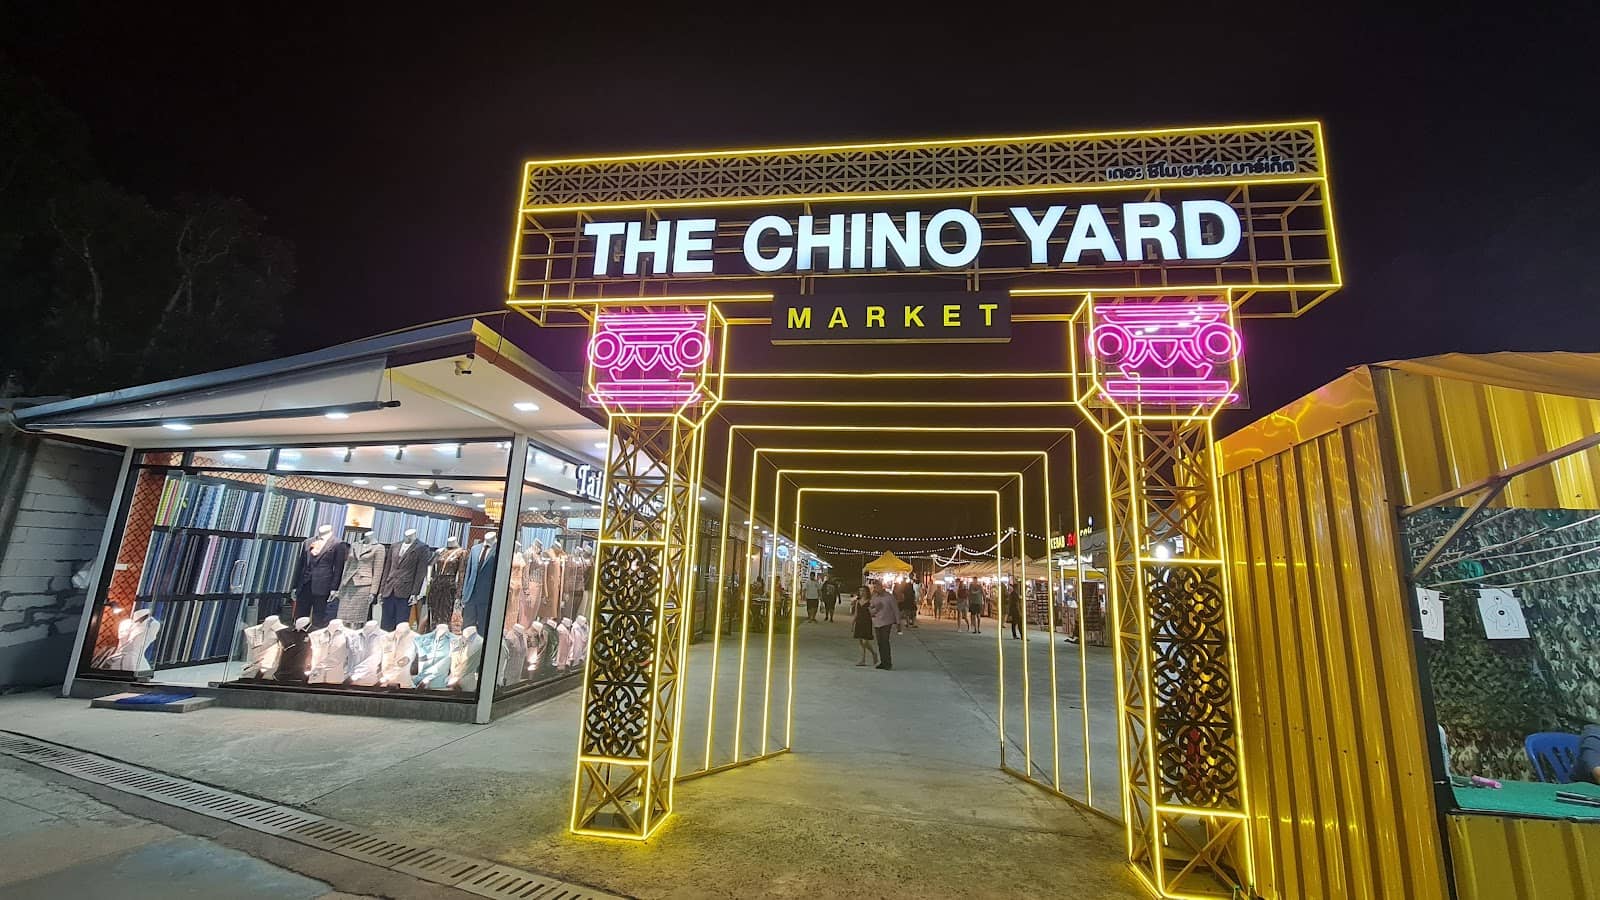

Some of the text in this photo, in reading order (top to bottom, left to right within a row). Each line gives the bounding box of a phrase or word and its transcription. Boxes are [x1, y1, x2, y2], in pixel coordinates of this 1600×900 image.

[583, 199, 1242, 277] THE CHINO YARD
[787, 303, 999, 329] MARKET
